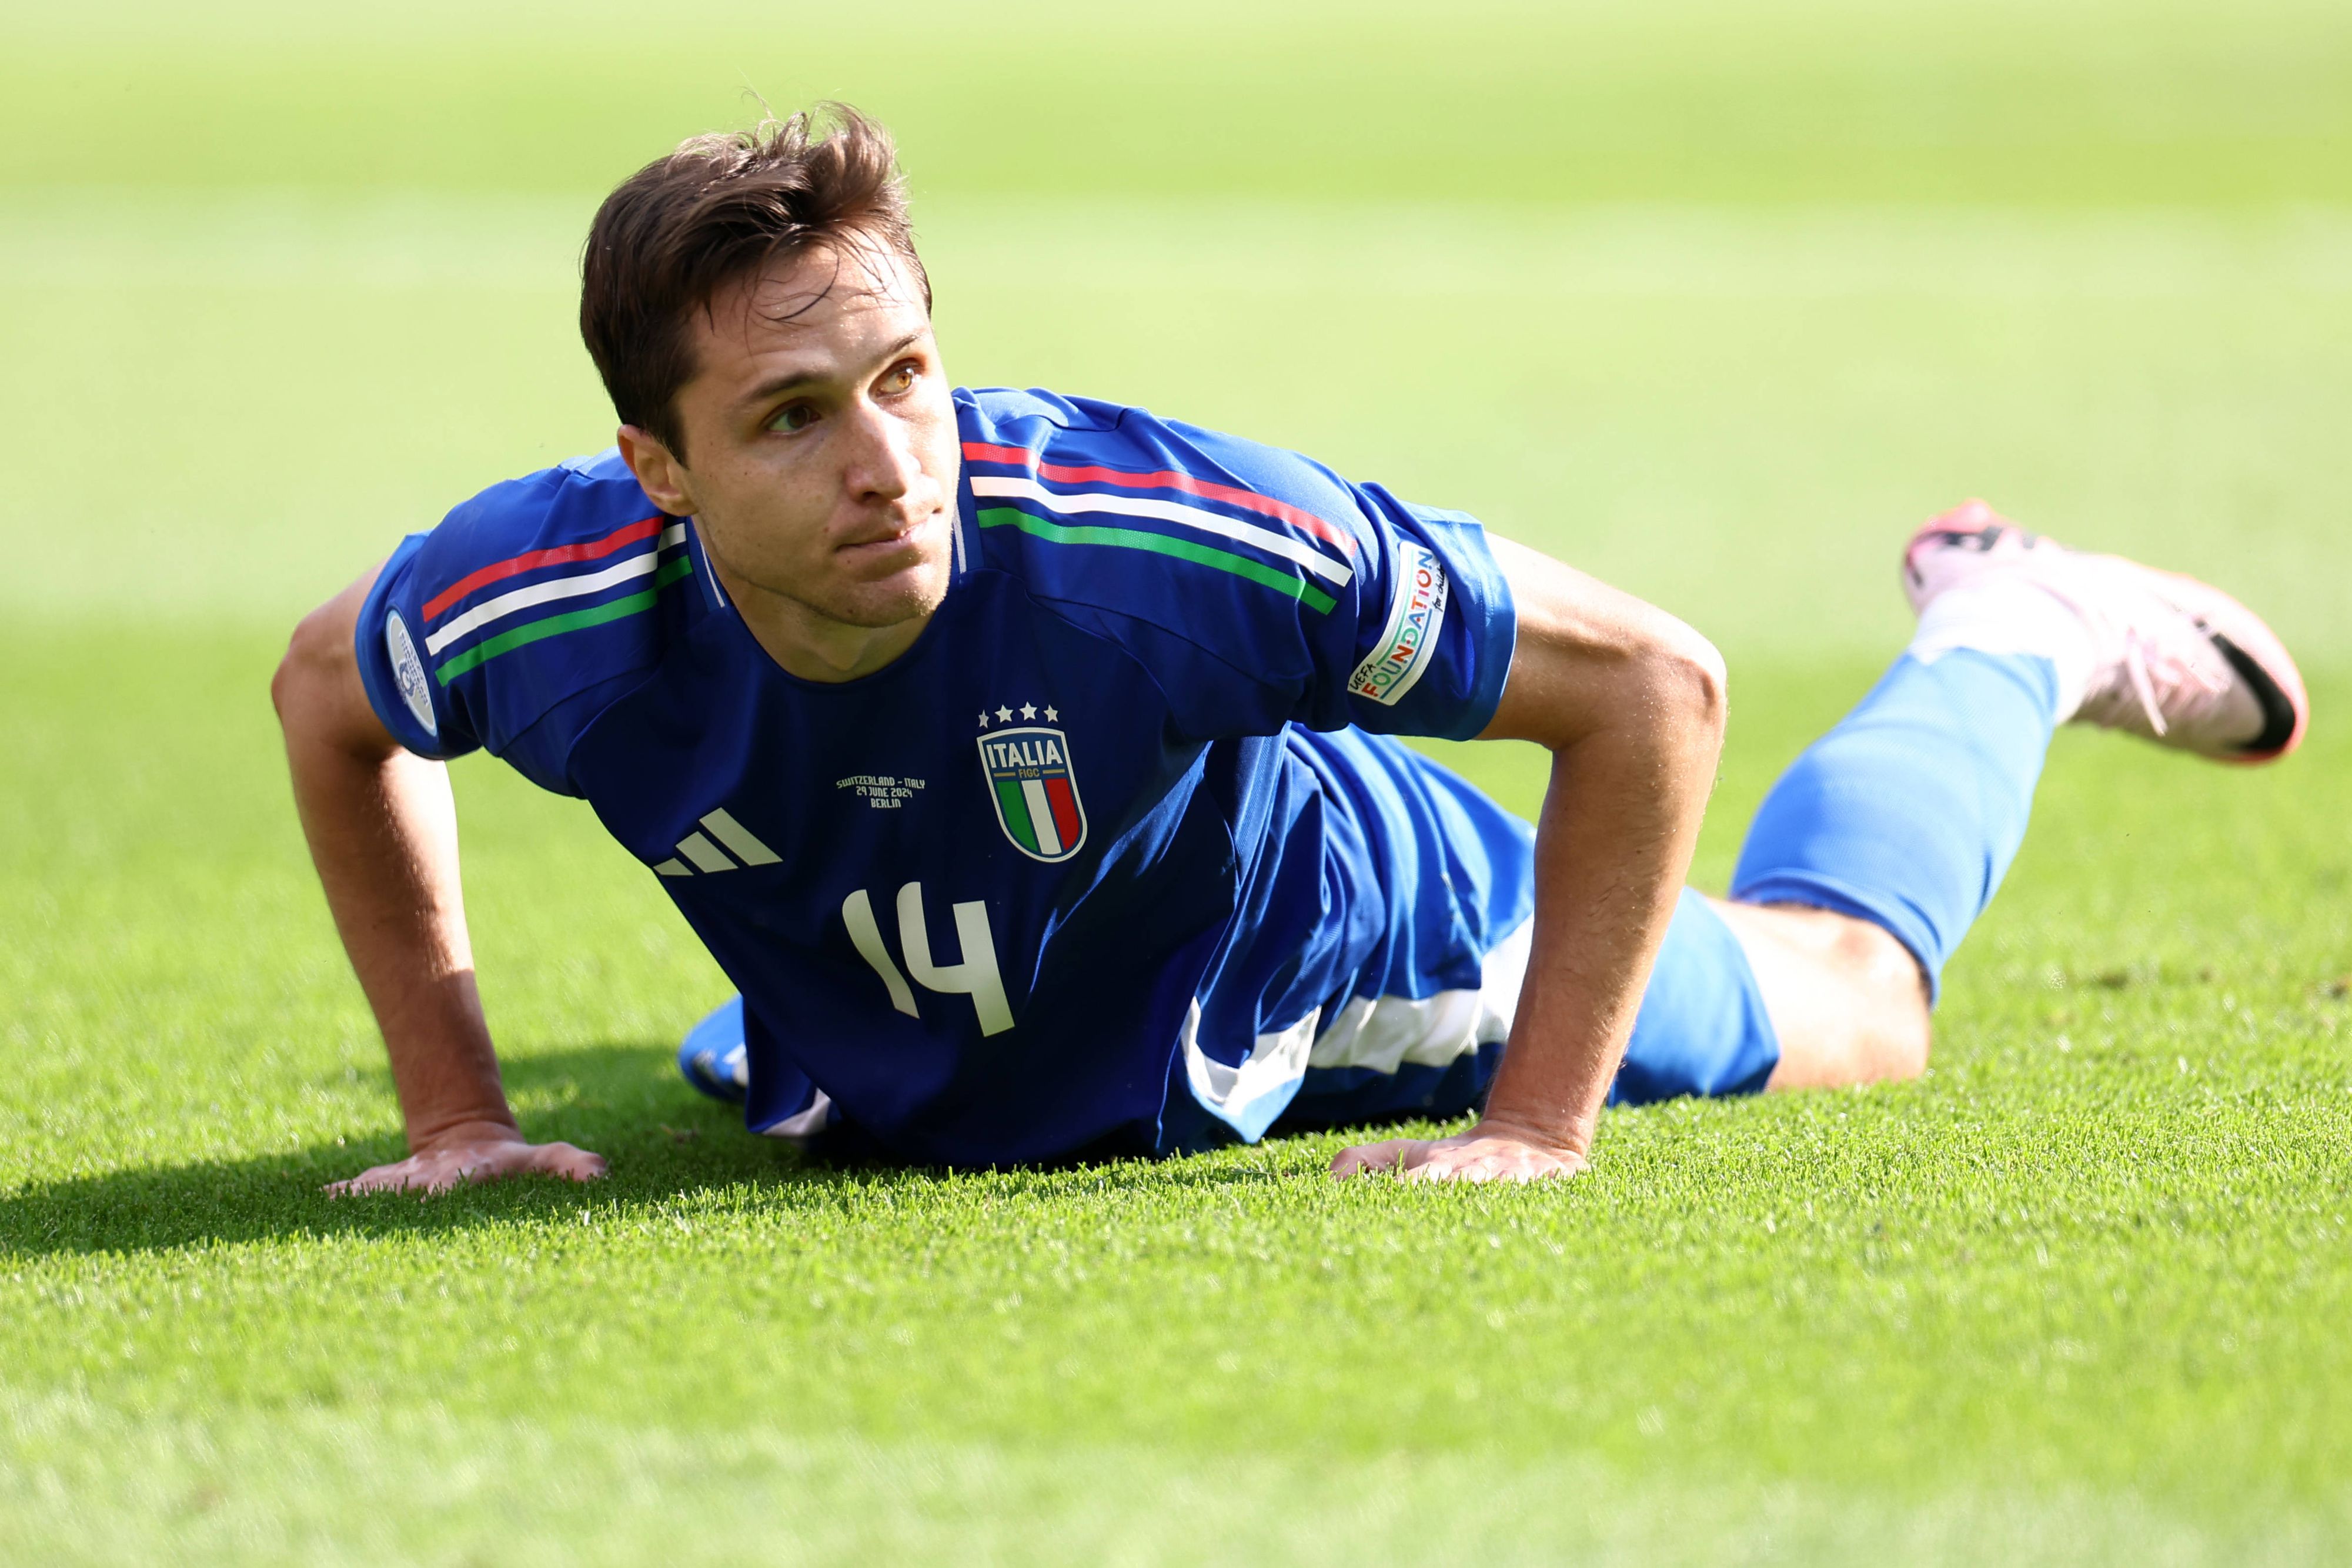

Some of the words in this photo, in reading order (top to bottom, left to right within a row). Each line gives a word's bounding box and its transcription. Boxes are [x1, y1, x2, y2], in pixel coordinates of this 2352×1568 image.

[1435, 564, 1445, 594] child
[1432, 595, 1444, 612] for
[1361, 550, 1434, 698] FOUNDATION
[1350, 663, 1376, 691] UEFA
[986, 739, 1063, 768] ITALIA
[836, 775, 896, 789] SWITZERLAND
[904, 777, 926, 789] ITALY
[1018, 767, 1040, 778] FIGC
[856, 785, 867, 795] 29
[868, 786, 889, 797] JUNE
[891, 787, 913, 798] 2024
[870, 797, 901, 808] BERLIN
[841, 881, 1015, 1038] 14
